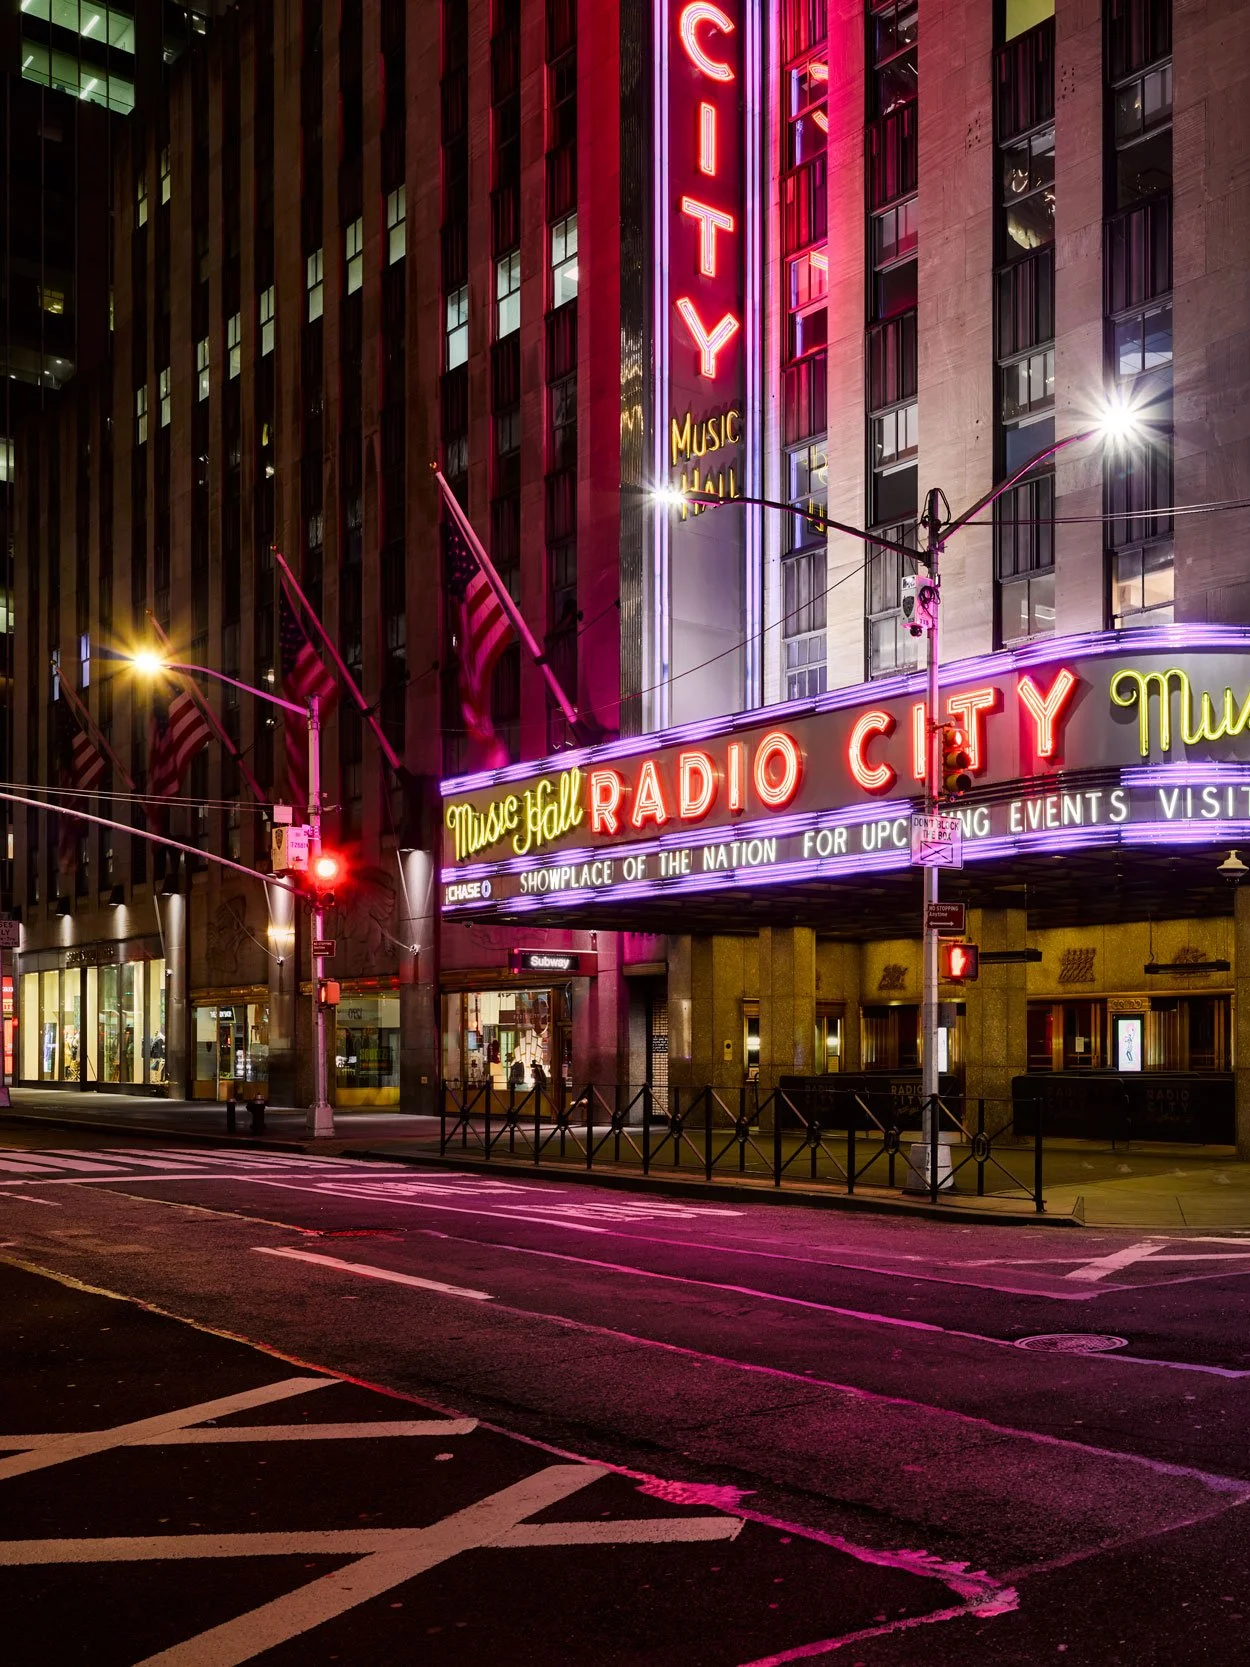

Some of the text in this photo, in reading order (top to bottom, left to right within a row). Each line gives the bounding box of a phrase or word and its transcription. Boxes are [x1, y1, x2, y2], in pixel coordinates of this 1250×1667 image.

[678, 1, 739, 379] CITY
[671, 409, 740, 466] MUSIC
[446, 794, 519, 862] Music
[513, 766, 584, 855] Hall
[590, 730, 802, 835] RADIO
[848, 666, 1078, 792] CITY
[519, 860, 612, 893] SHOWPLACE
[623, 853, 647, 881] OF
[658, 847, 692, 877] THE
[701, 836, 777, 873] NATION
[803, 826, 847, 856] FOR
[861, 806, 990, 852] UPCNG
[1009, 789, 1129, 834] EVENTS
[913, 817, 959, 831] DON'T BLOCK
[923, 829, 952, 841] THE BOX
[448, 882, 481, 901] CHASE
[529, 955, 570, 969] Subway
